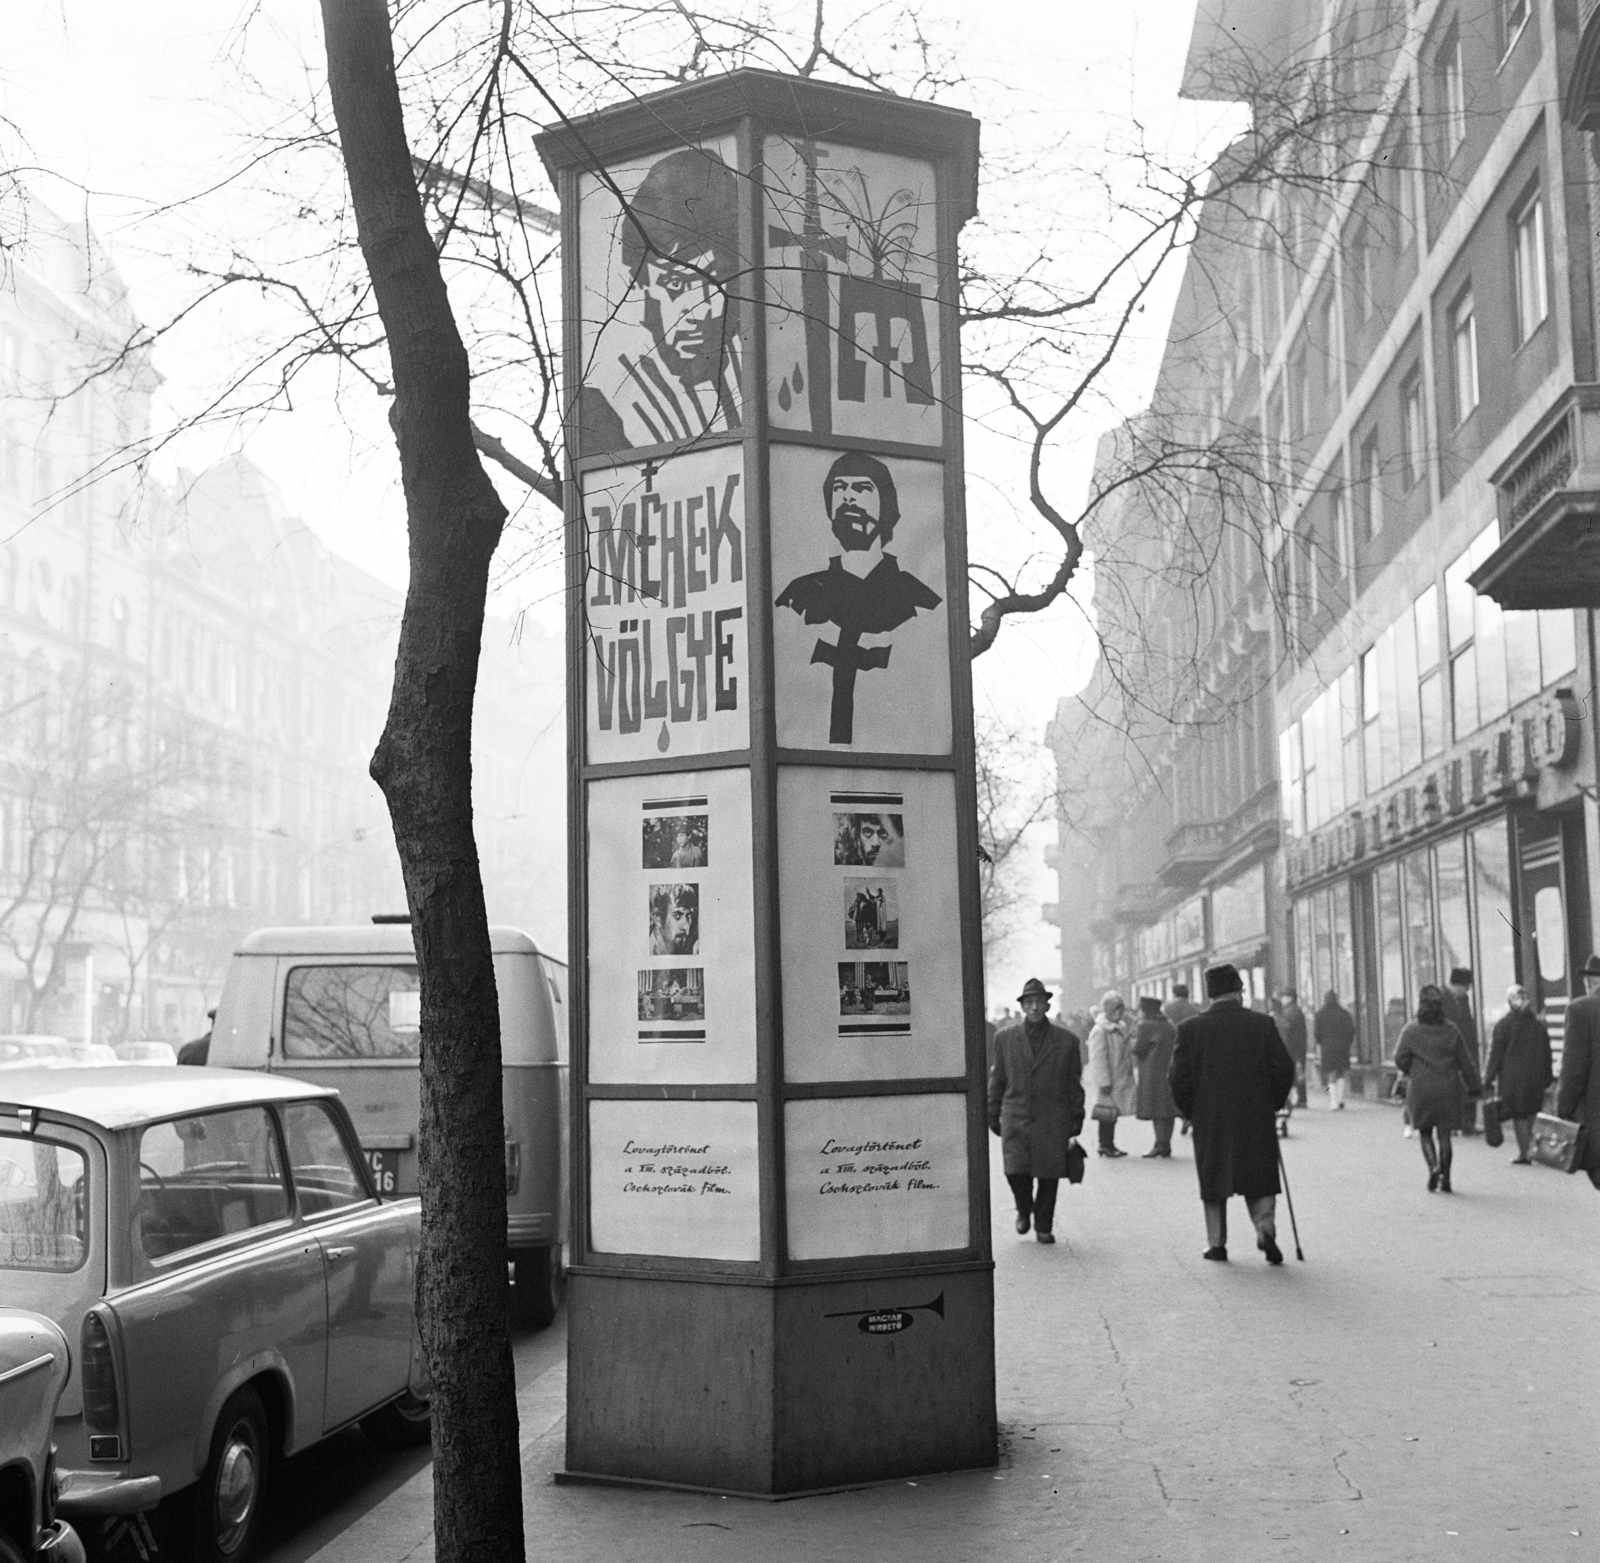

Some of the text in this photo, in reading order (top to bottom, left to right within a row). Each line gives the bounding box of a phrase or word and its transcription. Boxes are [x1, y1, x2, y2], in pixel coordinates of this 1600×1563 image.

[594, 606, 743, 735] VÖLGYE
[820, 1138, 922, 1156] Lovagtörténet
[836, 1162, 857, 1173] XIII.
[623, 1181, 731, 1195] Csehszlovák film.
[820, 1178, 940, 1195] Csehszlovák film.
[868, 1313, 902, 1323] MAGYAR
